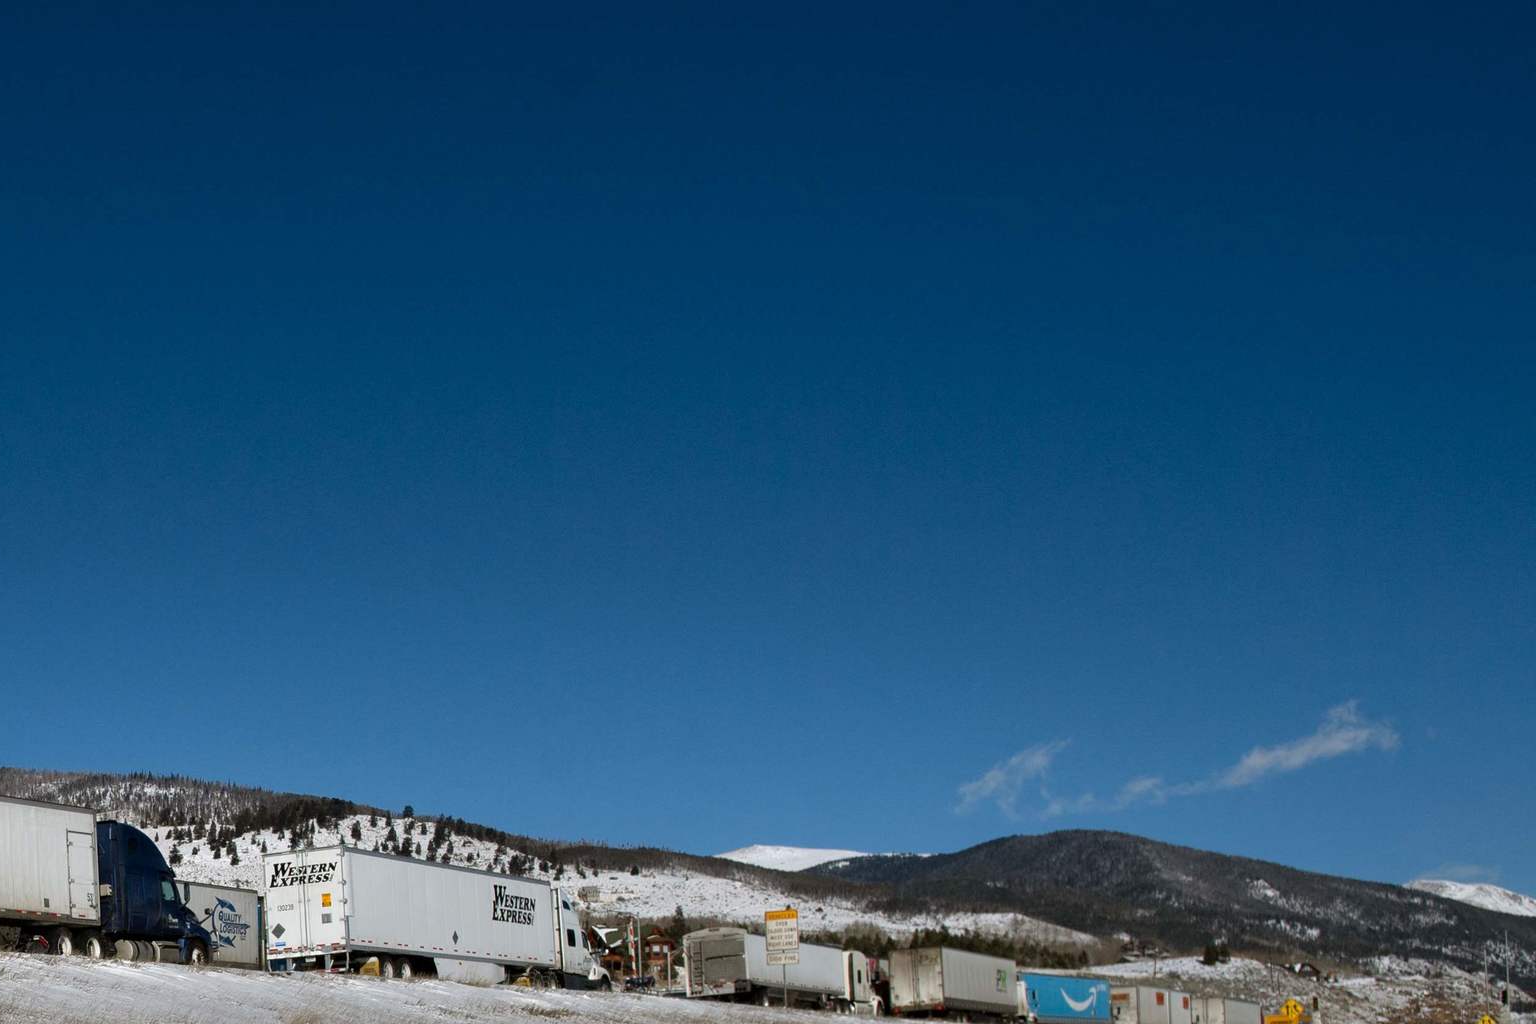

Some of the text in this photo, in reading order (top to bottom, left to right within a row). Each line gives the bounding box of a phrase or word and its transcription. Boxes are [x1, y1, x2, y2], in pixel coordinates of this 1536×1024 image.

[273, 862, 338, 877] WESTERN
[270, 873, 331, 888] EXPRESS
[493, 884, 536, 912] WESTERN
[219, 911, 241, 923] QUALITY
[492, 900, 533, 925] EXPRESS
[220, 923, 247, 935] LOGISTICS
